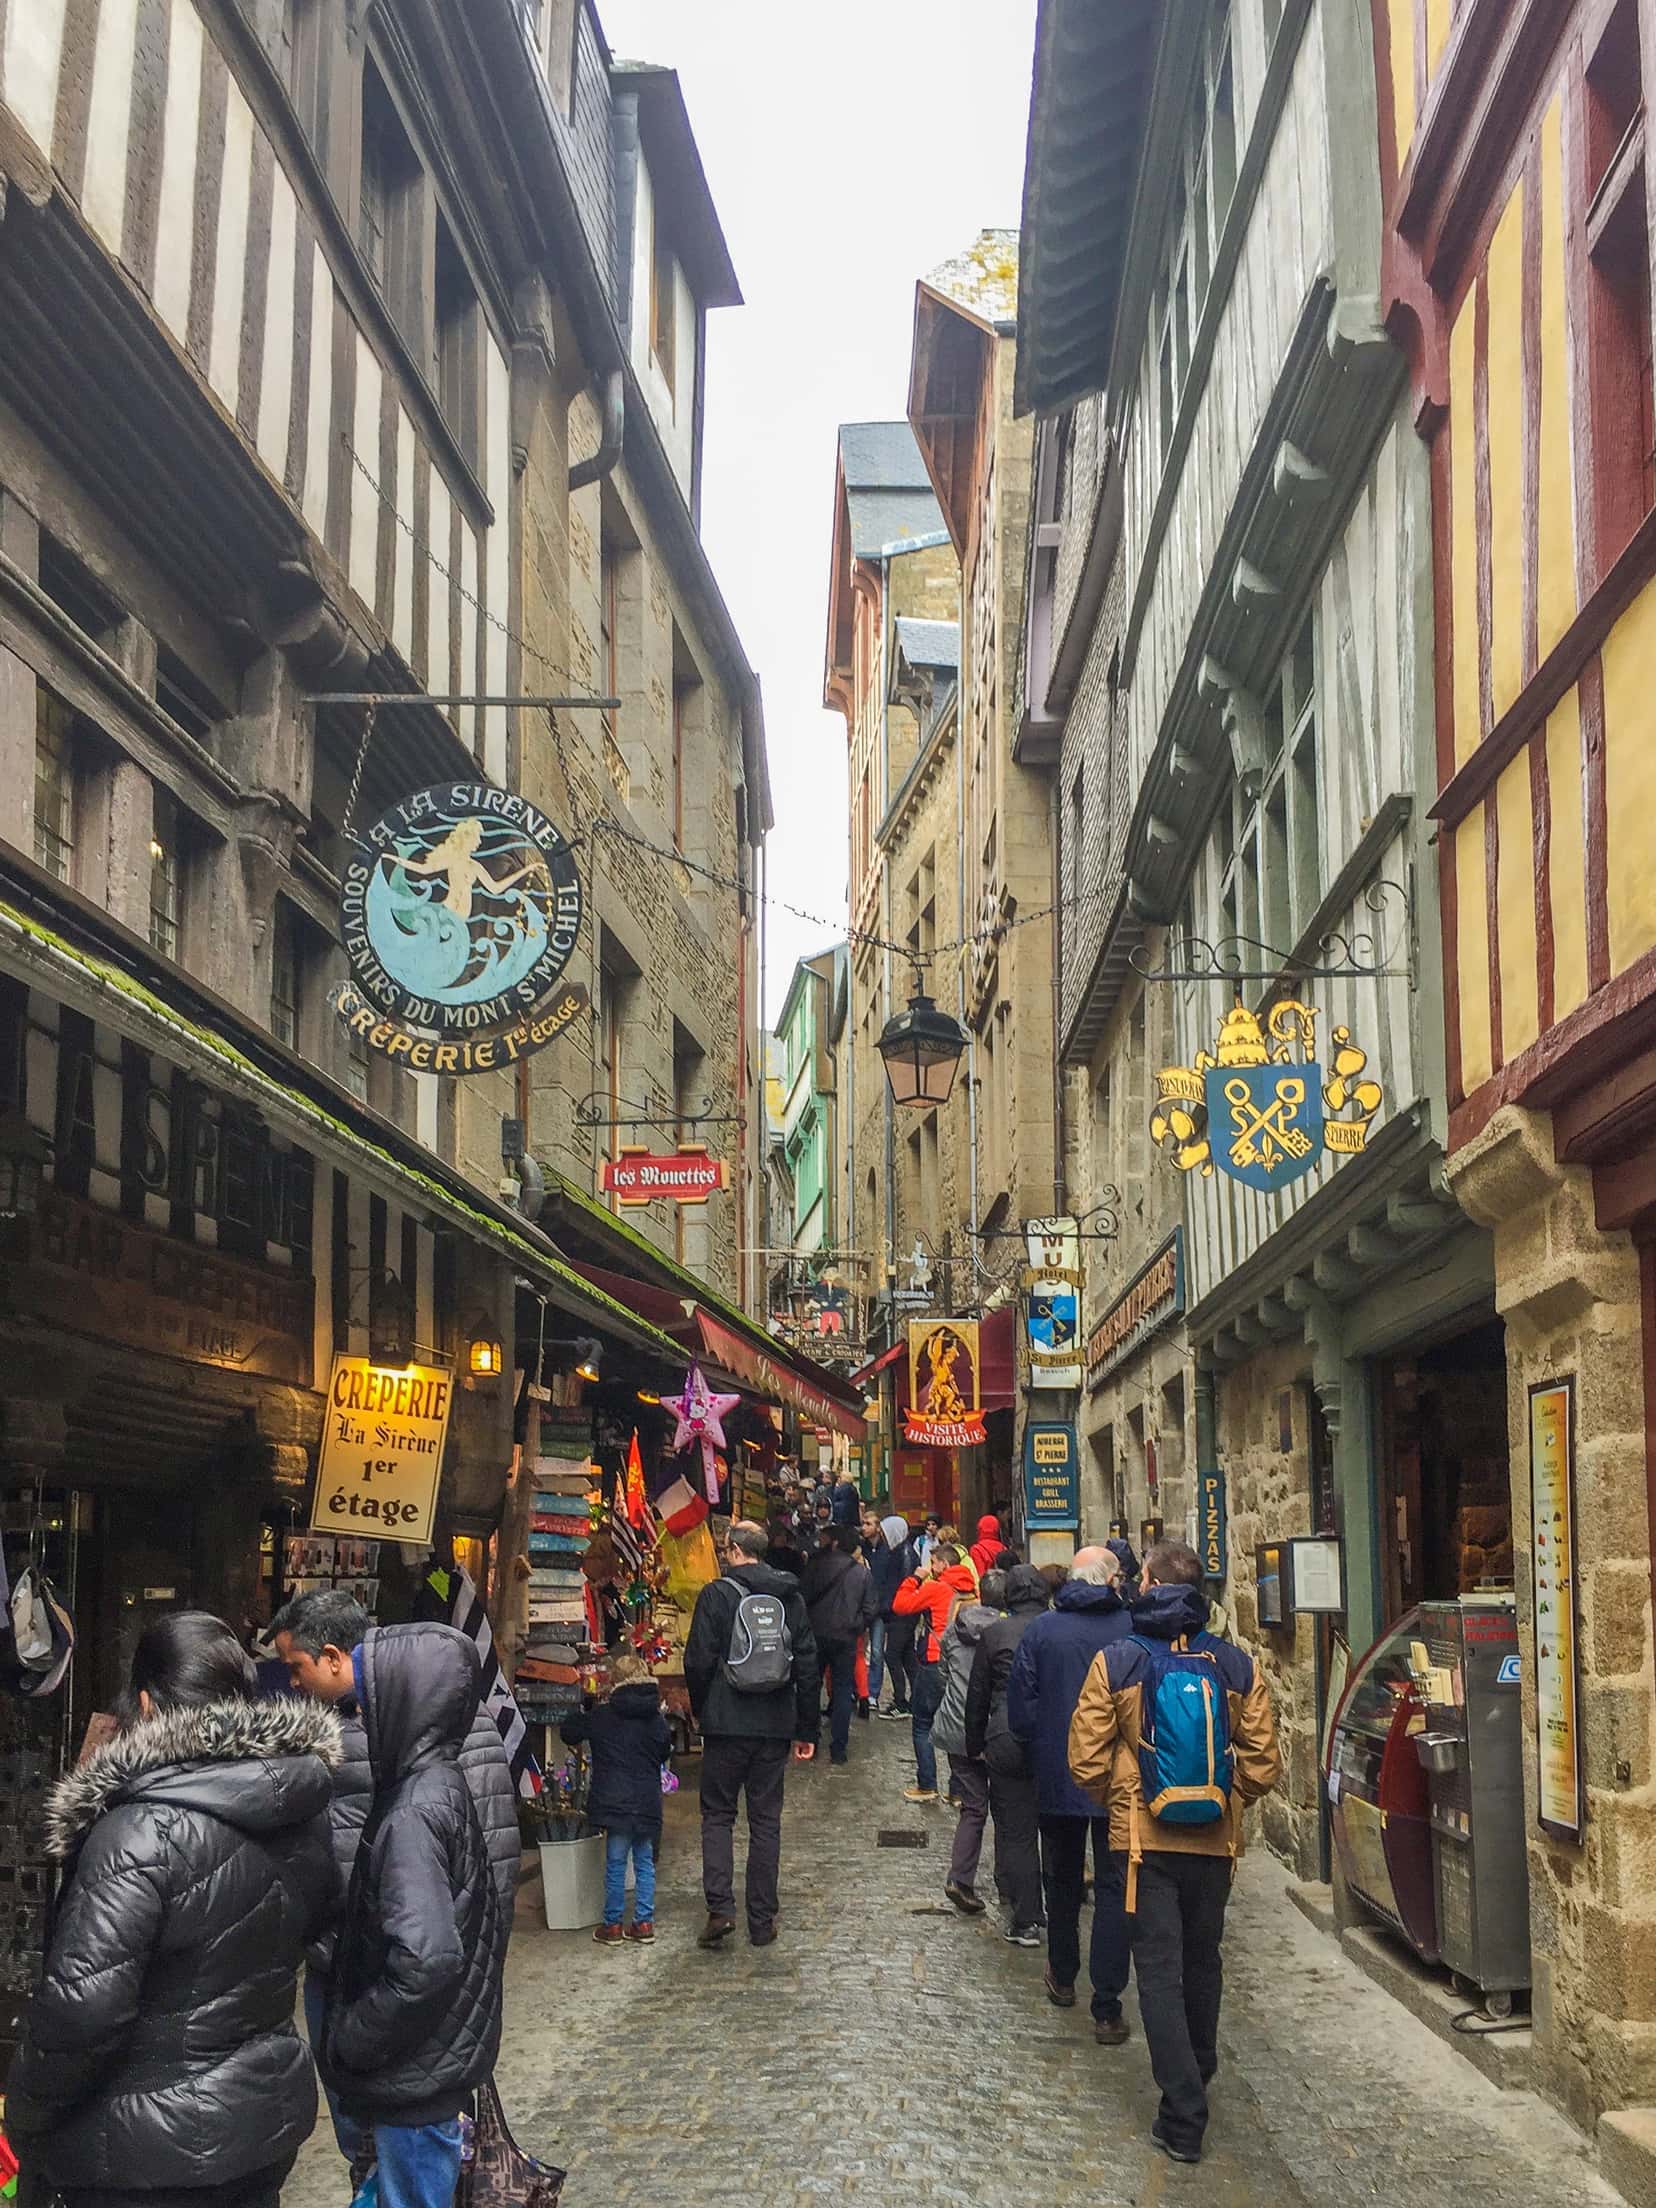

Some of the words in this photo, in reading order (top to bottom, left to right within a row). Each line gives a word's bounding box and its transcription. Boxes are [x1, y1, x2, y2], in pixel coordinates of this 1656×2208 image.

[397, 788, 438, 825] LA
[342, 863, 401, 1005] SOUVENIRS
[402, 998, 436, 1024] DU
[444, 996, 512, 1028] MONT
[532, 879, 579, 982] MICHEL
[640, 1166, 716, 1185] Mouettes
[333, 1368, 448, 1421] CREPERIE
[333, 1412, 365, 1450] La
[371, 1421, 437, 1454] Sirène
[909, 1429, 985, 1446] HISTORIQUE
[925, 1422, 966, 1434] VISITE
[361, 1459, 398, 1482] 1er
[1044, 1449, 1066, 1460] PIERRE
[329, 1487, 419, 1527] étage
[1205, 1479, 1221, 1572] PIZZAS
